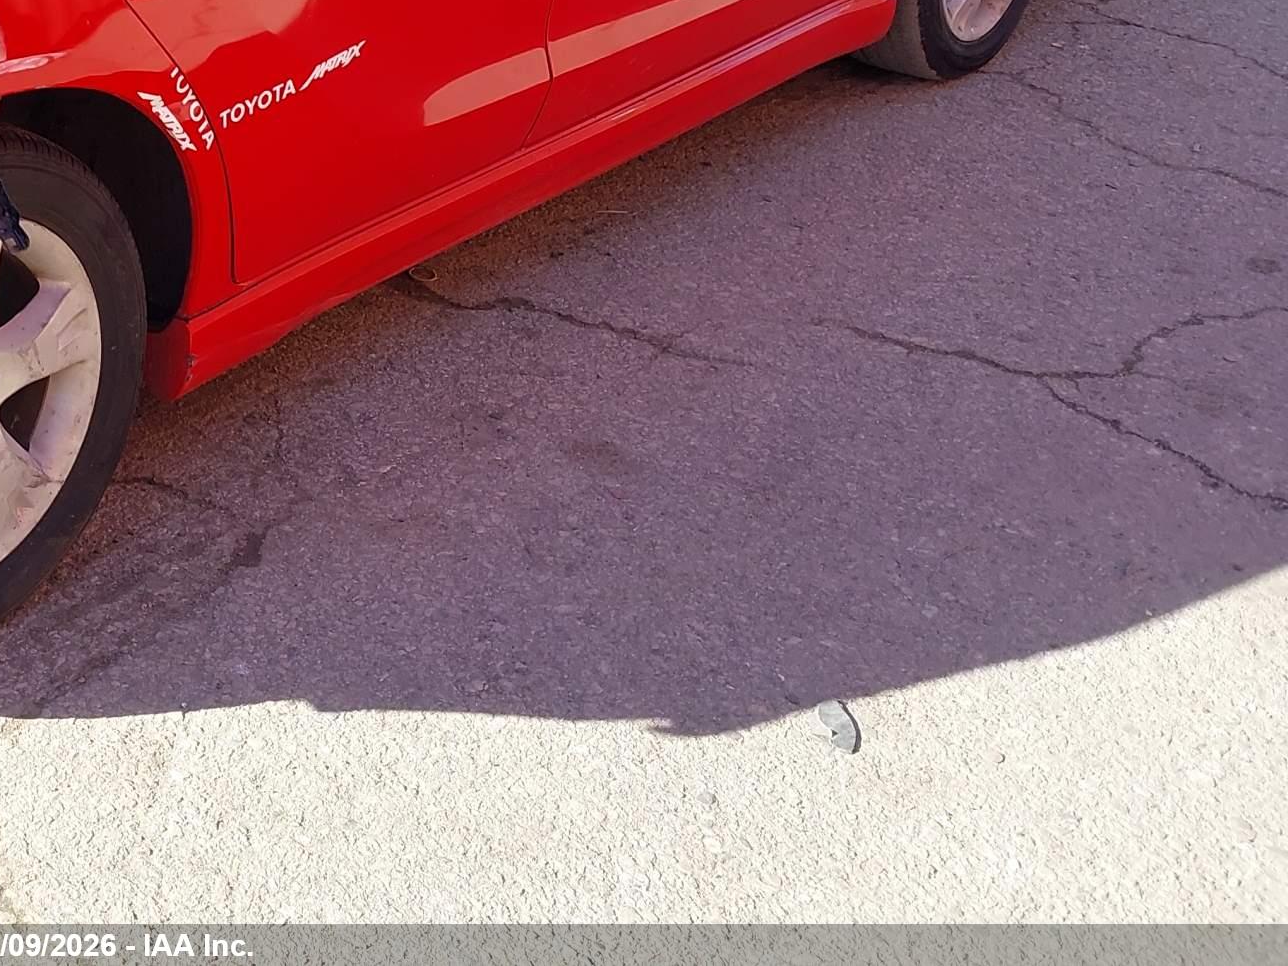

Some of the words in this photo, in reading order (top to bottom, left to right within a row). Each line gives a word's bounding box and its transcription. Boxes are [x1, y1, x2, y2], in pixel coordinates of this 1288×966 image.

[136, 90, 198, 152] MATRIX
[219, 79, 296, 129] TOYOTA
[298, 39, 366, 92] MATRIX
